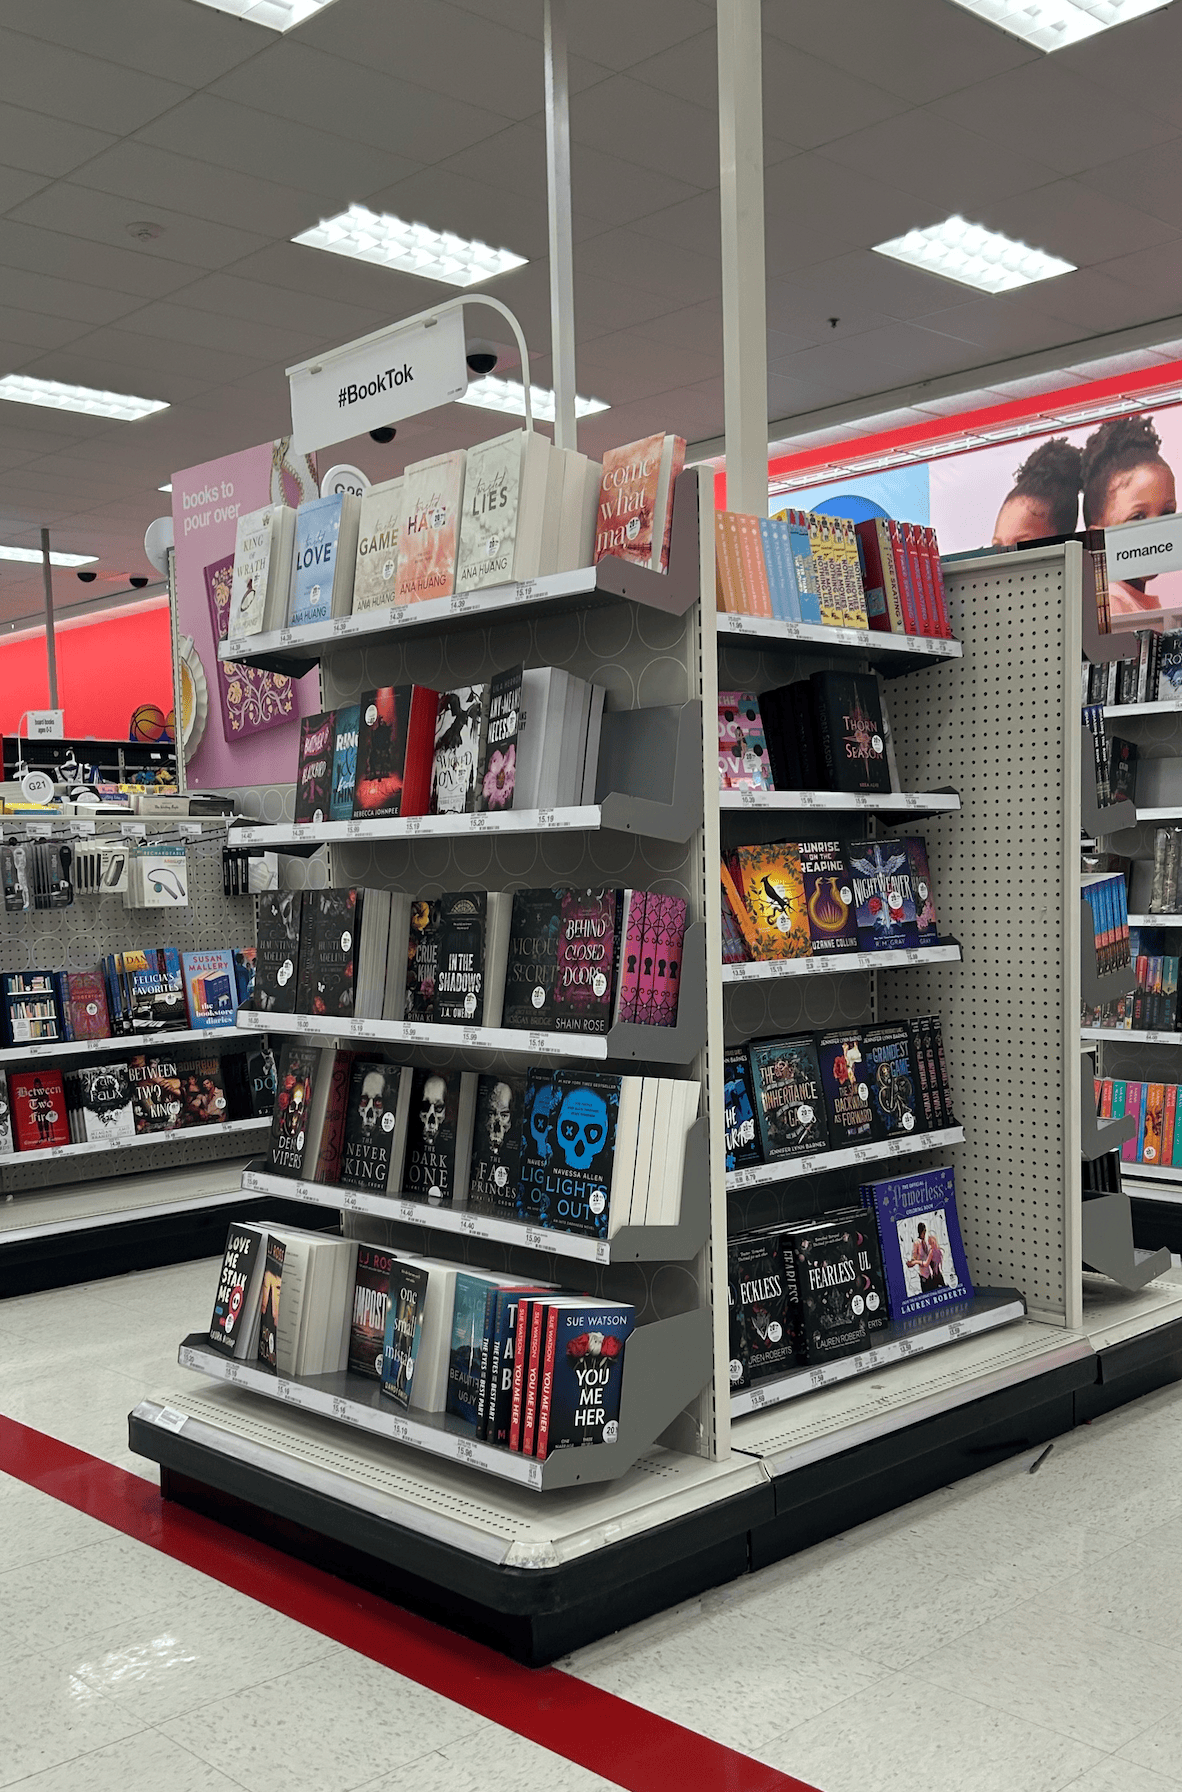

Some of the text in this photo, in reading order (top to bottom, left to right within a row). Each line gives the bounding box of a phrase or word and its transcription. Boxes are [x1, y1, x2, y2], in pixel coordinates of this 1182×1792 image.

[338, 364, 414, 408] #BookTok
[602, 456, 656, 492] come
[182, 481, 235, 509] books to
[472, 485, 508, 517] LIES
[600, 487, 648, 522] what
[183, 502, 242, 535] pour over
[243, 534, 264, 552] KING
[359, 528, 399, 556] GAME
[297, 542, 332, 571] LOVE
[1116, 542, 1174, 561] romance
[237, 557, 266, 577] WRATH
[461, 557, 508, 581] ANA HUANG
[400, 575, 447, 595] ANA HUANG
[817, 555, 830, 608] NOTHING LIKE
[829, 558, 842, 611] NOTHING LIKE
[841, 559, 855, 612] NOTHING LIKE
[854, 561, 867, 613] NOTHING LIKE
[515, 587, 532, 598] 15.19
[890, 576, 902, 617] SKATING
[357, 598, 372, 612] ANA
[451, 600, 466, 610] 14.39
[390, 612, 404, 621] 14.39
[843, 716, 878, 733] THORN
[845, 743, 883, 761] SEASON
[29, 781, 46, 791] G21
[354, 809, 374, 817] REBECCA
[538, 815, 554, 823] 15.19
[347, 826, 360, 834] 15.99
[406, 823, 419, 831] 15.19
[470, 819, 485, 827] 15.20
[798, 842, 841, 854] SUNRISE
[801, 861, 844, 873] REAPING
[852, 875, 915, 908] NIGHTWEAVER
[566, 918, 606, 940] BEHIND
[565, 944, 605, 961] CLOSED
[812, 937, 858, 950] UZANNE COLLINS
[188, 962, 229, 971] MALLERY
[193, 955, 223, 963] SUSAN
[448, 954, 474, 971] IN THE
[133, 972, 175, 984] FELICIA'S
[438, 972, 482, 993] SHADOWS
[563, 966, 602, 987] DOORS
[132, 984, 179, 996] FAVORITES
[196, 1009, 233, 1018] bookstore
[206, 1017, 233, 1025] diaries
[403, 1028, 416, 1036] 15.99
[555, 1017, 605, 1032] SHAIN ROSE
[463, 1033, 478, 1041] 15.99
[529, 1039, 545, 1047] 15.16
[872, 1041, 909, 1063] GRANDEST
[128, 1063, 177, 1081] BETWEEN
[759, 1065, 777, 1086] THE
[16, 1086, 61, 1100] Between
[136, 1084, 161, 1100] TWO
[761, 1081, 818, 1113] INHERITANCE
[28, 1098, 54, 1110] Two
[842, 1108, 873, 1126] FORWARD
[362, 1137, 373, 1145] THE
[769, 1147, 791, 1156] JENNIFER
[805, 1140, 826, 1149] BARNES
[272, 1149, 302, 1169] VIPERS
[347, 1142, 388, 1162] NEVER
[412, 1150, 448, 1168] DARK
[344, 1158, 387, 1181] KING
[410, 1165, 448, 1188] ONE
[553, 1168, 604, 1182] NAVESSA ALLEN
[296, 1188, 308, 1196] 14.40
[471, 1181, 517, 1199] PRINCES
[546, 1175, 608, 1200] LIGHTS
[893, 1182, 944, 1208] Powerless
[344, 1198, 357, 1206] 14.40
[557, 1199, 590, 1221] OUT
[400, 1208, 413, 1217] 14.40
[460, 1221, 475, 1230] 14.40
[228, 1234, 251, 1255] LOVE
[526, 1234, 541, 1244] 15.99
[225, 1250, 239, 1269] ME
[359, 1251, 370, 1265] LJ
[222, 1267, 247, 1291] STALK
[808, 1260, 856, 1291] FEARLESS
[218, 1285, 231, 1303] ME
[740, 1275, 782, 1305] ECKLESS
[353, 1285, 388, 1332] IMPOST
[901, 1299, 931, 1314] LAUREN
[933, 1287, 967, 1304] ROBERTS
[394, 1315, 417, 1338] small
[566, 1315, 628, 1327] SUE WATSON
[816, 1329, 867, 1350] LAUREN ROBERTS
[385, 1343, 412, 1366] mista
[480, 1350, 488, 1370] EYES
[576, 1368, 610, 1386] YOU
[457, 1389, 477, 1406] UGLY
[513, 1384, 521, 1402] ME
[526, 1367, 537, 1429] YOU ME HER
[579, 1388, 604, 1406] ME
[477, 1398, 485, 1418] PART
[540, 1371, 552, 1434] YOU ME HER
[488, 1402, 496, 1422] PART
[512, 1402, 520, 1425] HER
[574, 1409, 605, 1427] HER
[394, 1425, 408, 1435] 15.19
